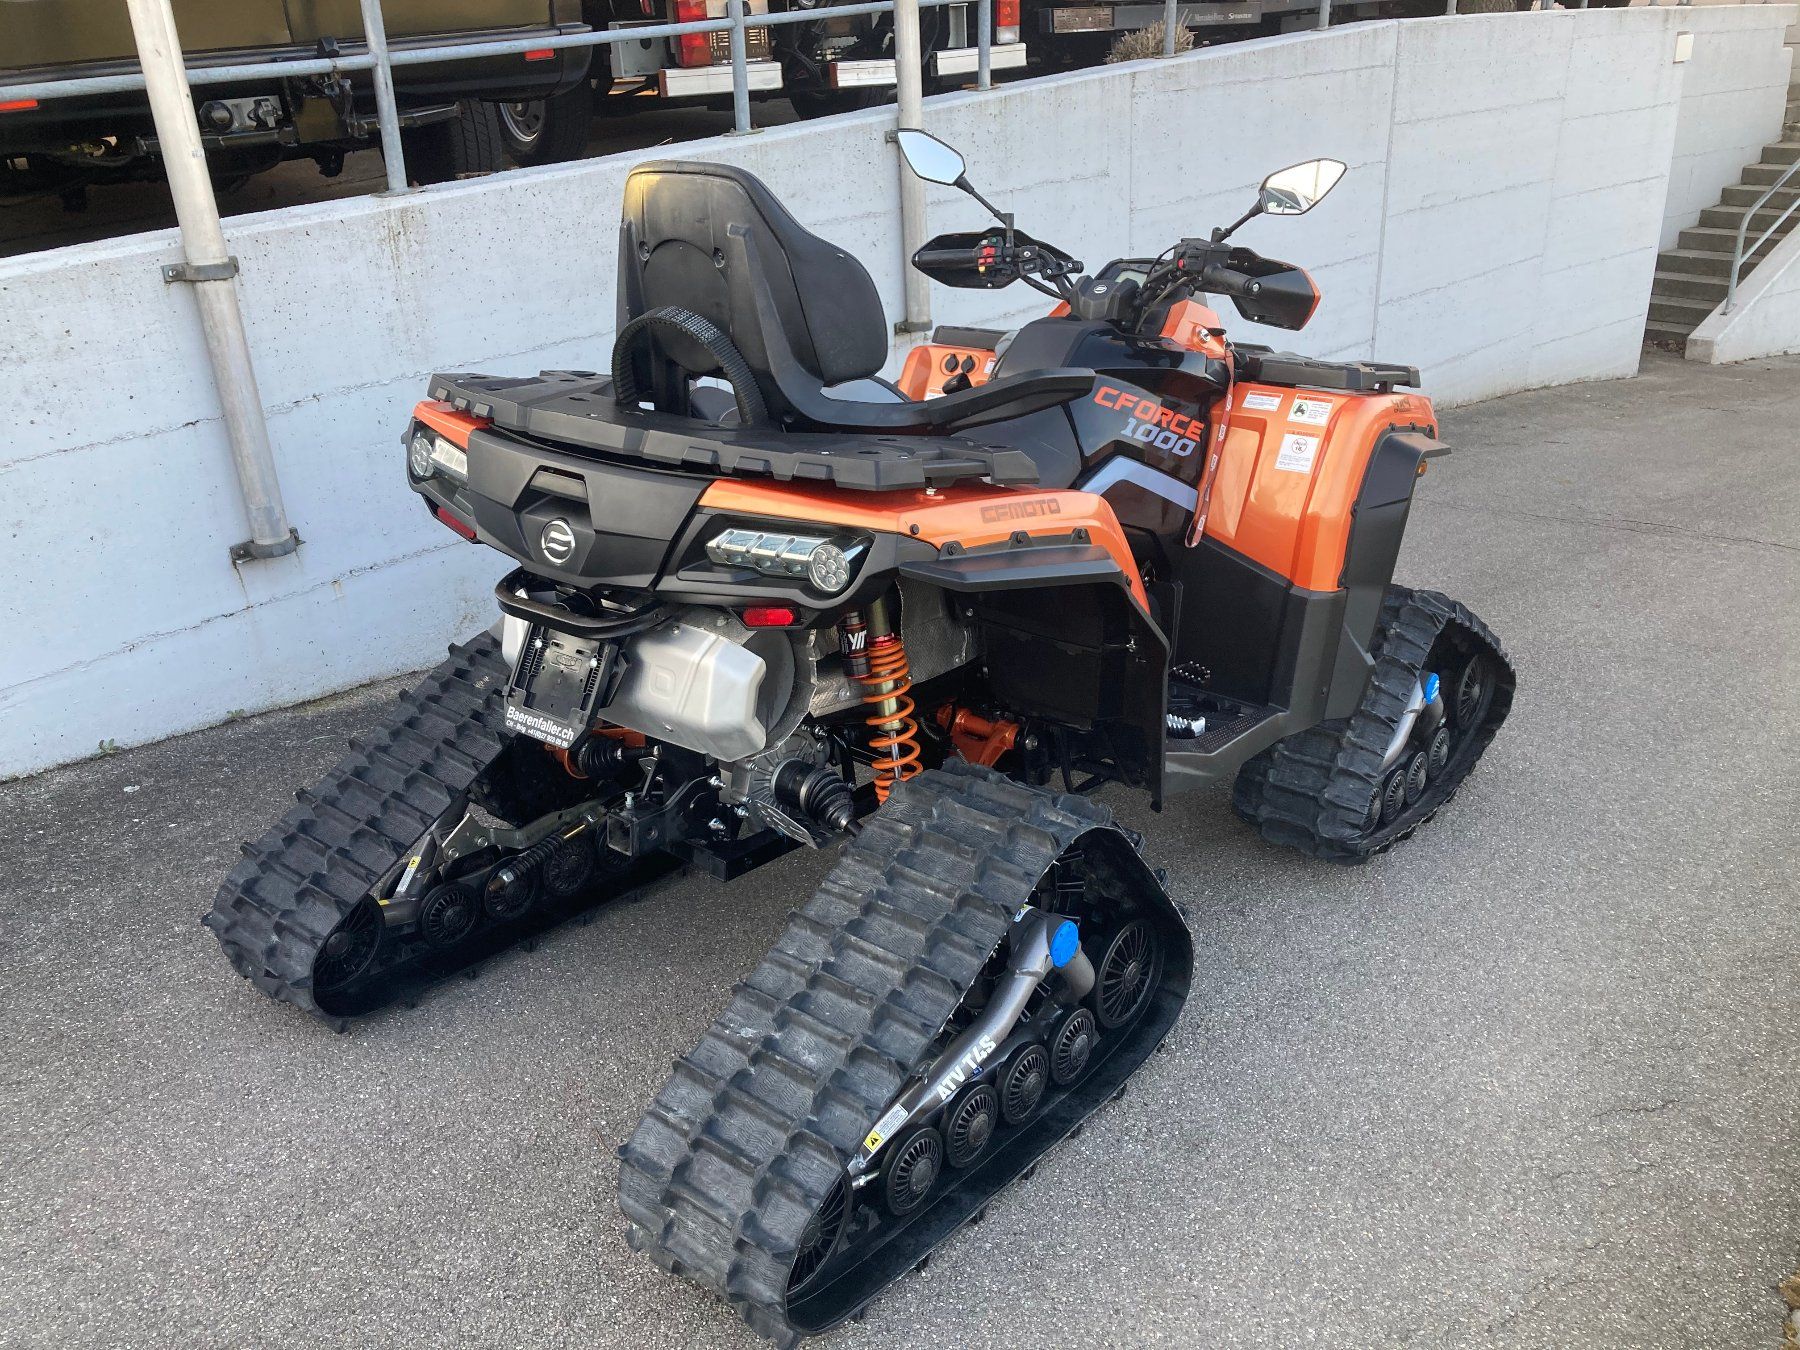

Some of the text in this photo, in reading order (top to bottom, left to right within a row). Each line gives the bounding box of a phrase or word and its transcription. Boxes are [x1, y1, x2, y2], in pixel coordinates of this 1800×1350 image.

[1094, 386, 1205, 442] CFORCE
[1120, 417, 1197, 457] 1000
[980, 498, 1061, 524] CFMOTO
[506, 705, 575, 740] Baerenfaller.ch
[937, 1034, 997, 1101] ATV T4S
